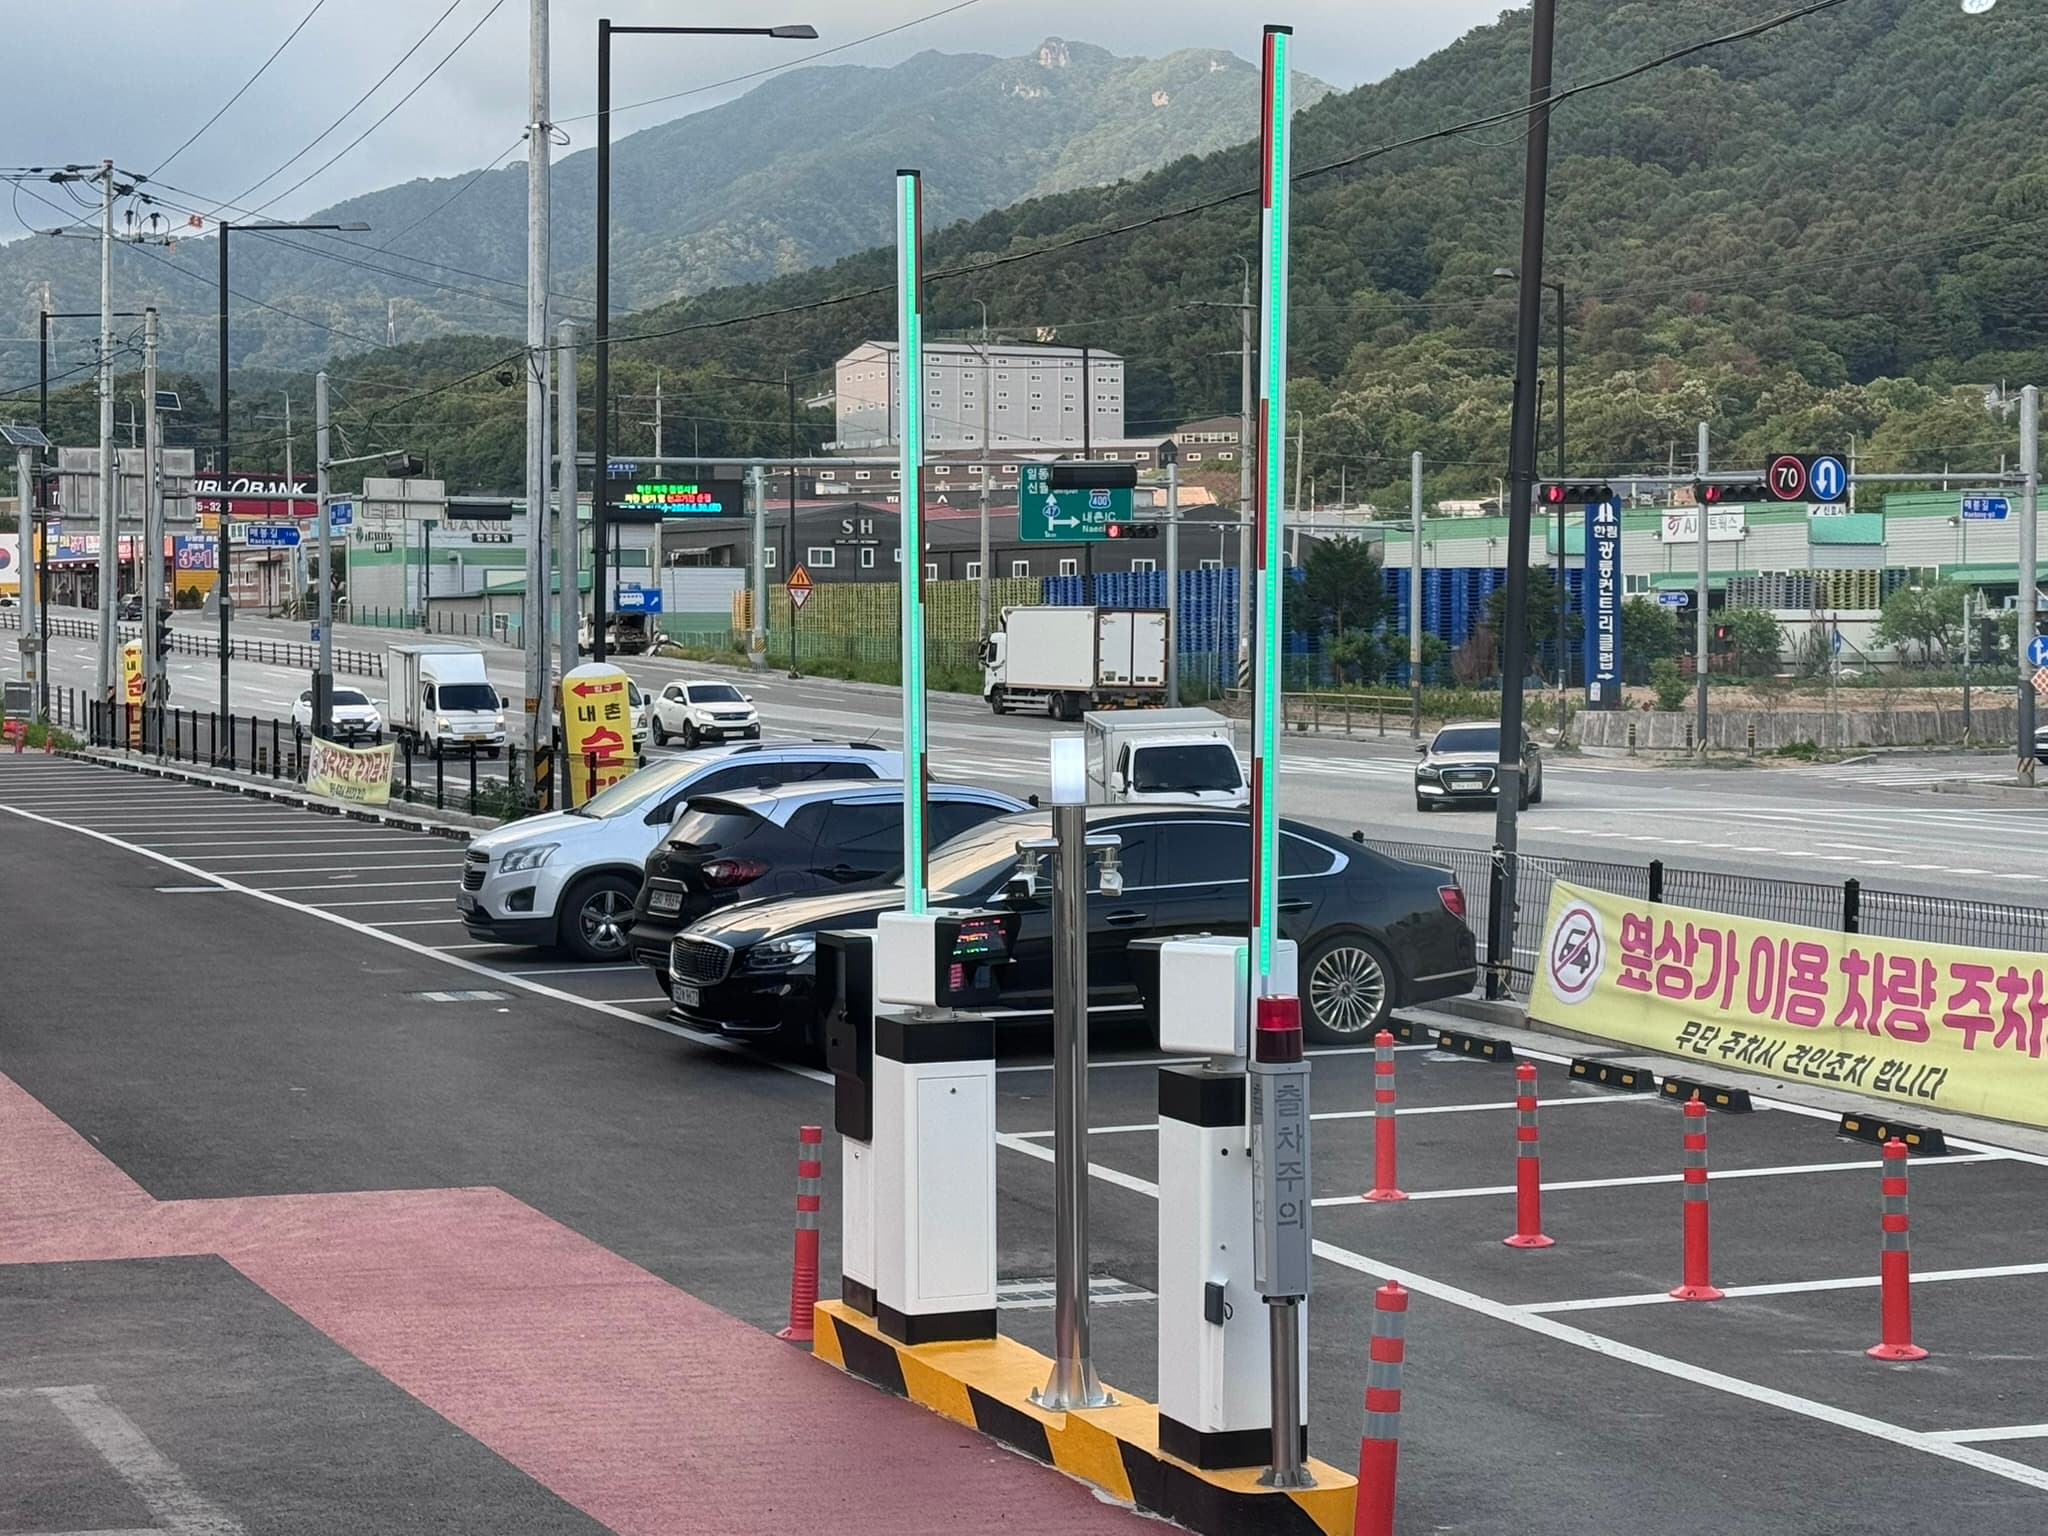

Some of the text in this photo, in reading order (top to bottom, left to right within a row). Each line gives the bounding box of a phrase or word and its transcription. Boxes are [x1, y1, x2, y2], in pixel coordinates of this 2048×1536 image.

[1027, 468, 1049, 480] 일동
[1778, 467, 1798, 488] 70
[1092, 496, 1107, 506] 400
[1045, 507, 1056, 516] 47
[578, 702, 621, 722] 내촌
[1616, 912, 1740, 1010] 옆상가
[1747, 936, 1829, 1027] 이용
[1836, 948, 1937, 1044] 차량
[1675, 1020, 1948, 1100] 무단 주차시 견인조치 합니다
[1275, 1083, 1305, 1230] 출차주의
